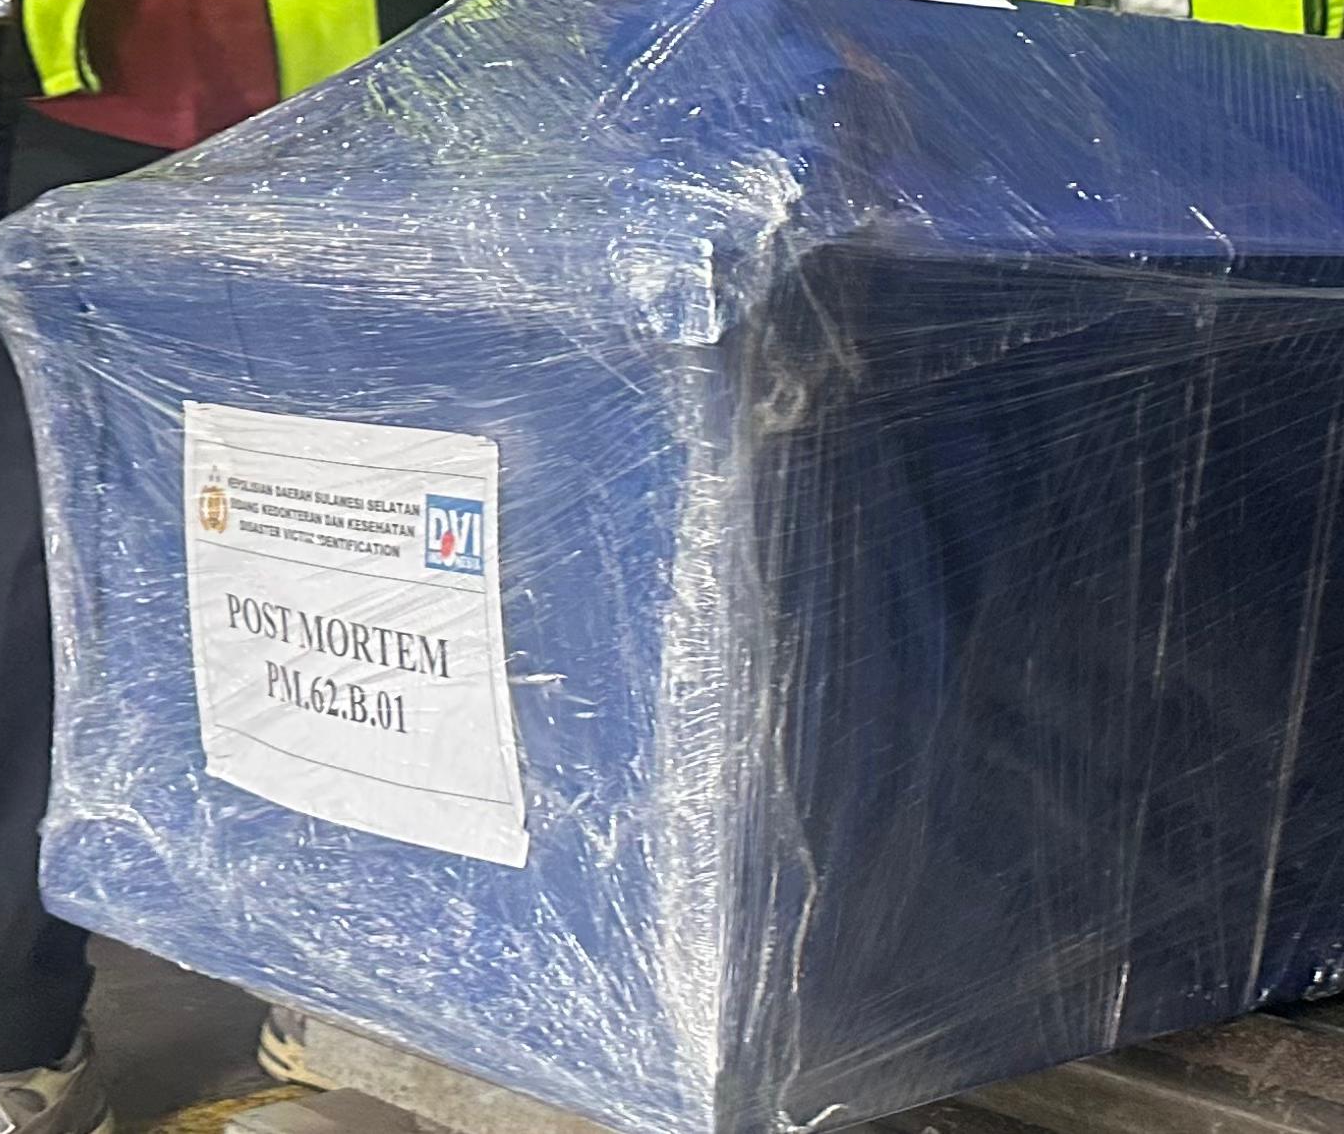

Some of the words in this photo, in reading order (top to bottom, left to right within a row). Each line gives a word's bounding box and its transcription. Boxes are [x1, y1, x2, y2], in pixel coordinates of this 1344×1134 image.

[261, 502, 322, 524] KEDOKTERAN
[324, 513, 346, 529] DAN
[347, 517, 416, 537] KESEHATAN
[275, 485, 313, 502] DAERAH
[314, 492, 364, 510] SULAWESI
[366, 499, 420, 516] SELATAN
[239, 519, 281, 537] DISASTER
[428, 507, 482, 557] DVI
[226, 593, 291, 644] POST
[298, 611, 451, 679] MORTEM
[265, 660, 408, 734] PM.62.B.01
